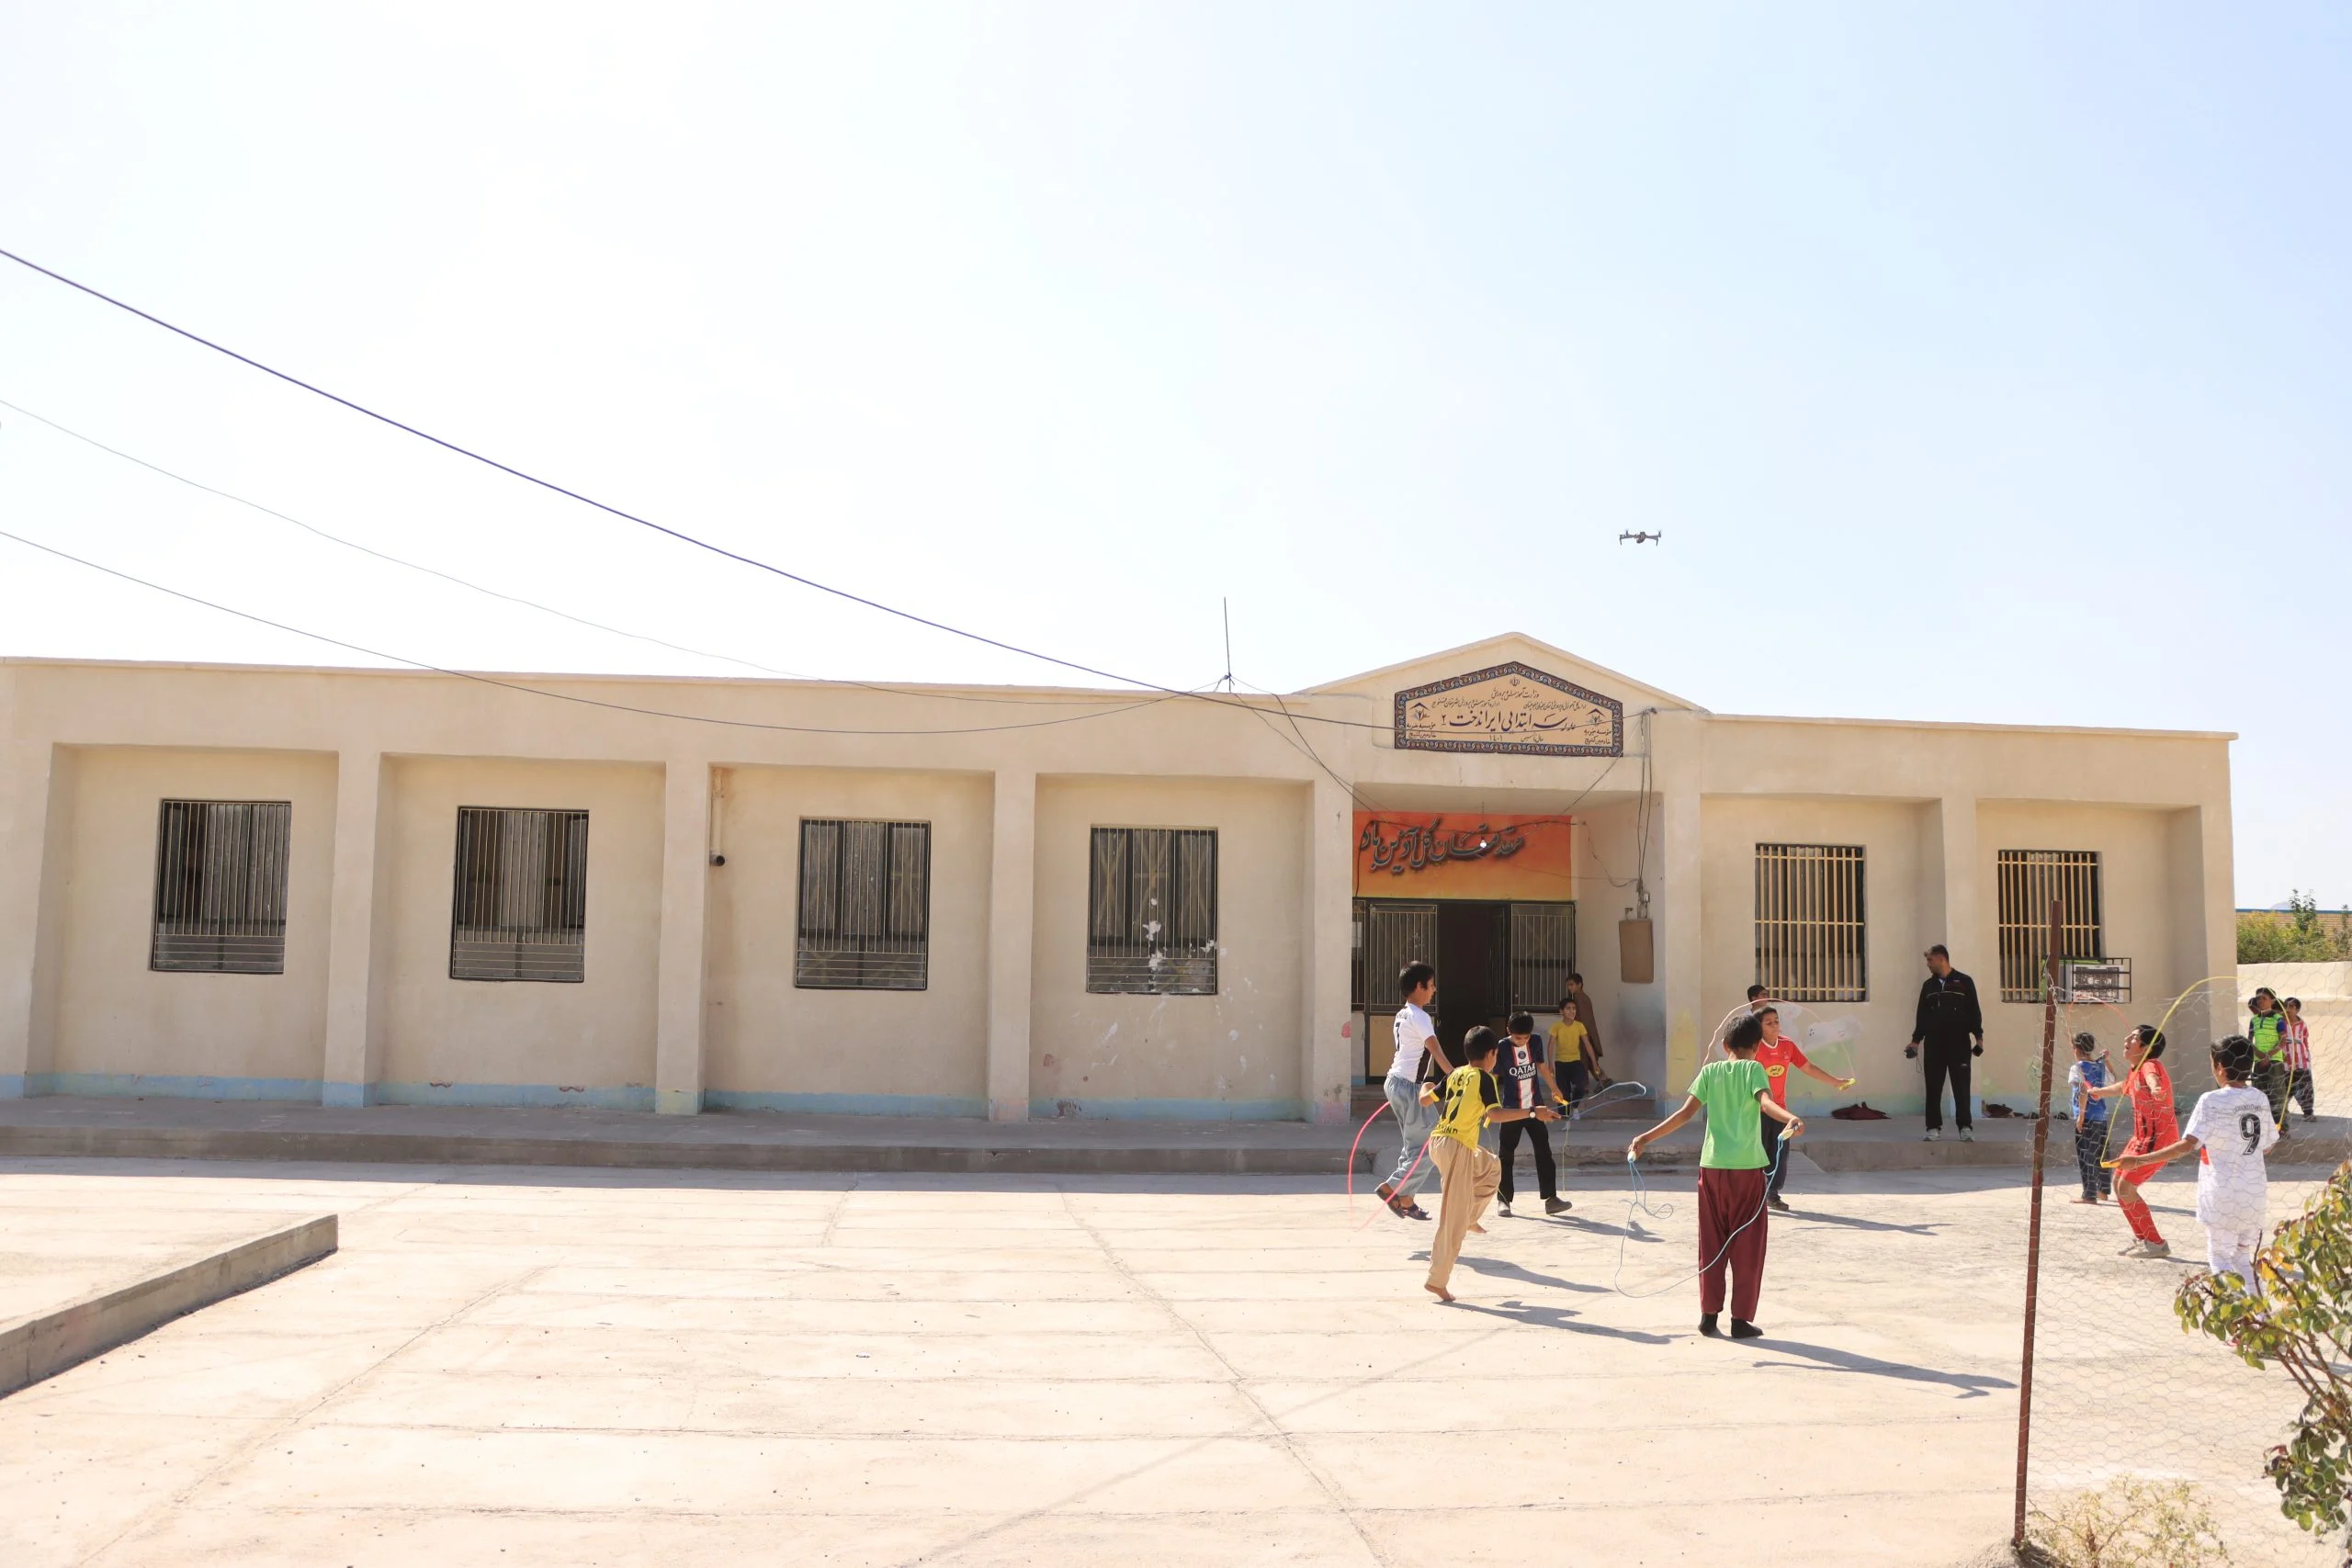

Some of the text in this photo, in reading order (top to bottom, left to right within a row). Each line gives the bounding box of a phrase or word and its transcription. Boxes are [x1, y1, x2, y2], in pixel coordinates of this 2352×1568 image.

[1491, 687, 1506, 700] پرورش
[1504, 687, 1526, 701] آموزش
[1522, 688, 1540, 698] وزارت
[1449, 710, 1501, 732] ایراندخت
[1532, 714, 1576, 731] مدرسه
[1395, 1021, 1401, 1052] 7
[2238, 1112, 2261, 1156] 9
